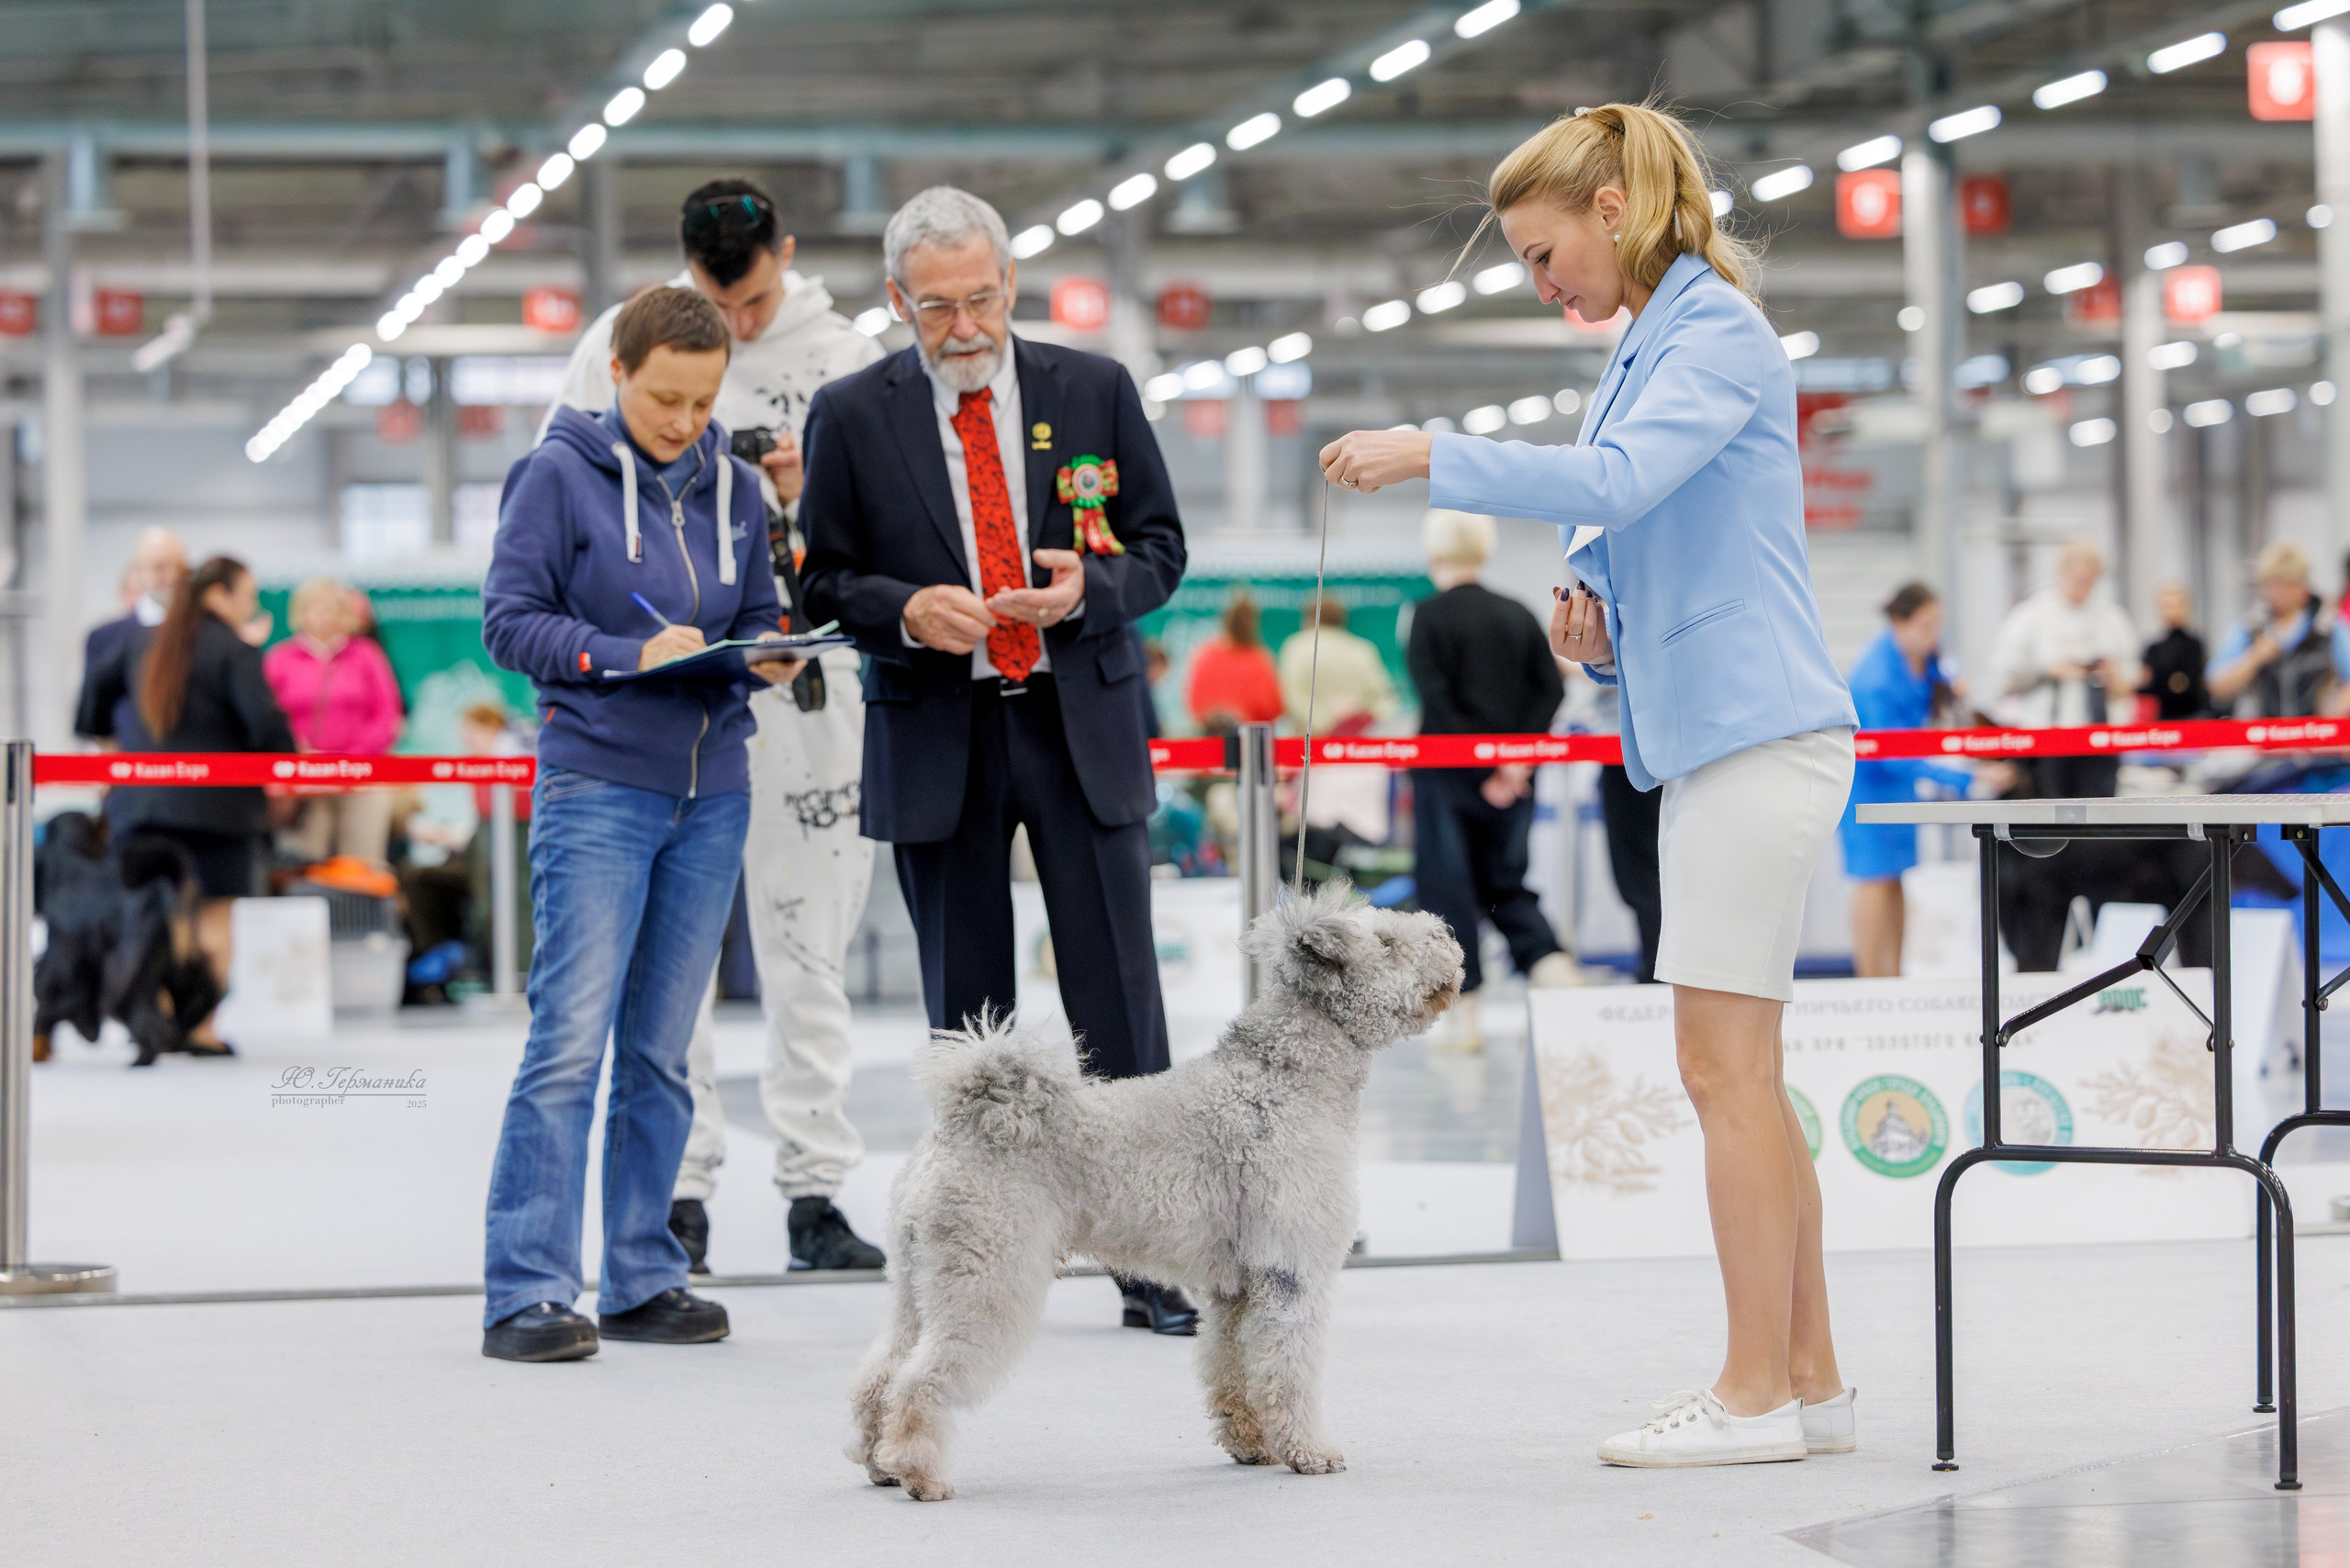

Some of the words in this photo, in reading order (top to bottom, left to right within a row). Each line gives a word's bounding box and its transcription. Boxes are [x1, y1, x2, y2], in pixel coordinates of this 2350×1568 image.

[135, 761, 174, 778] Kazan
[175, 761, 209, 780] Expo
[297, 760, 337, 778] Kazan
[338, 759, 373, 779] Expo
[456, 761, 495, 778] Kazan
[496, 761, 530, 780] Expo
